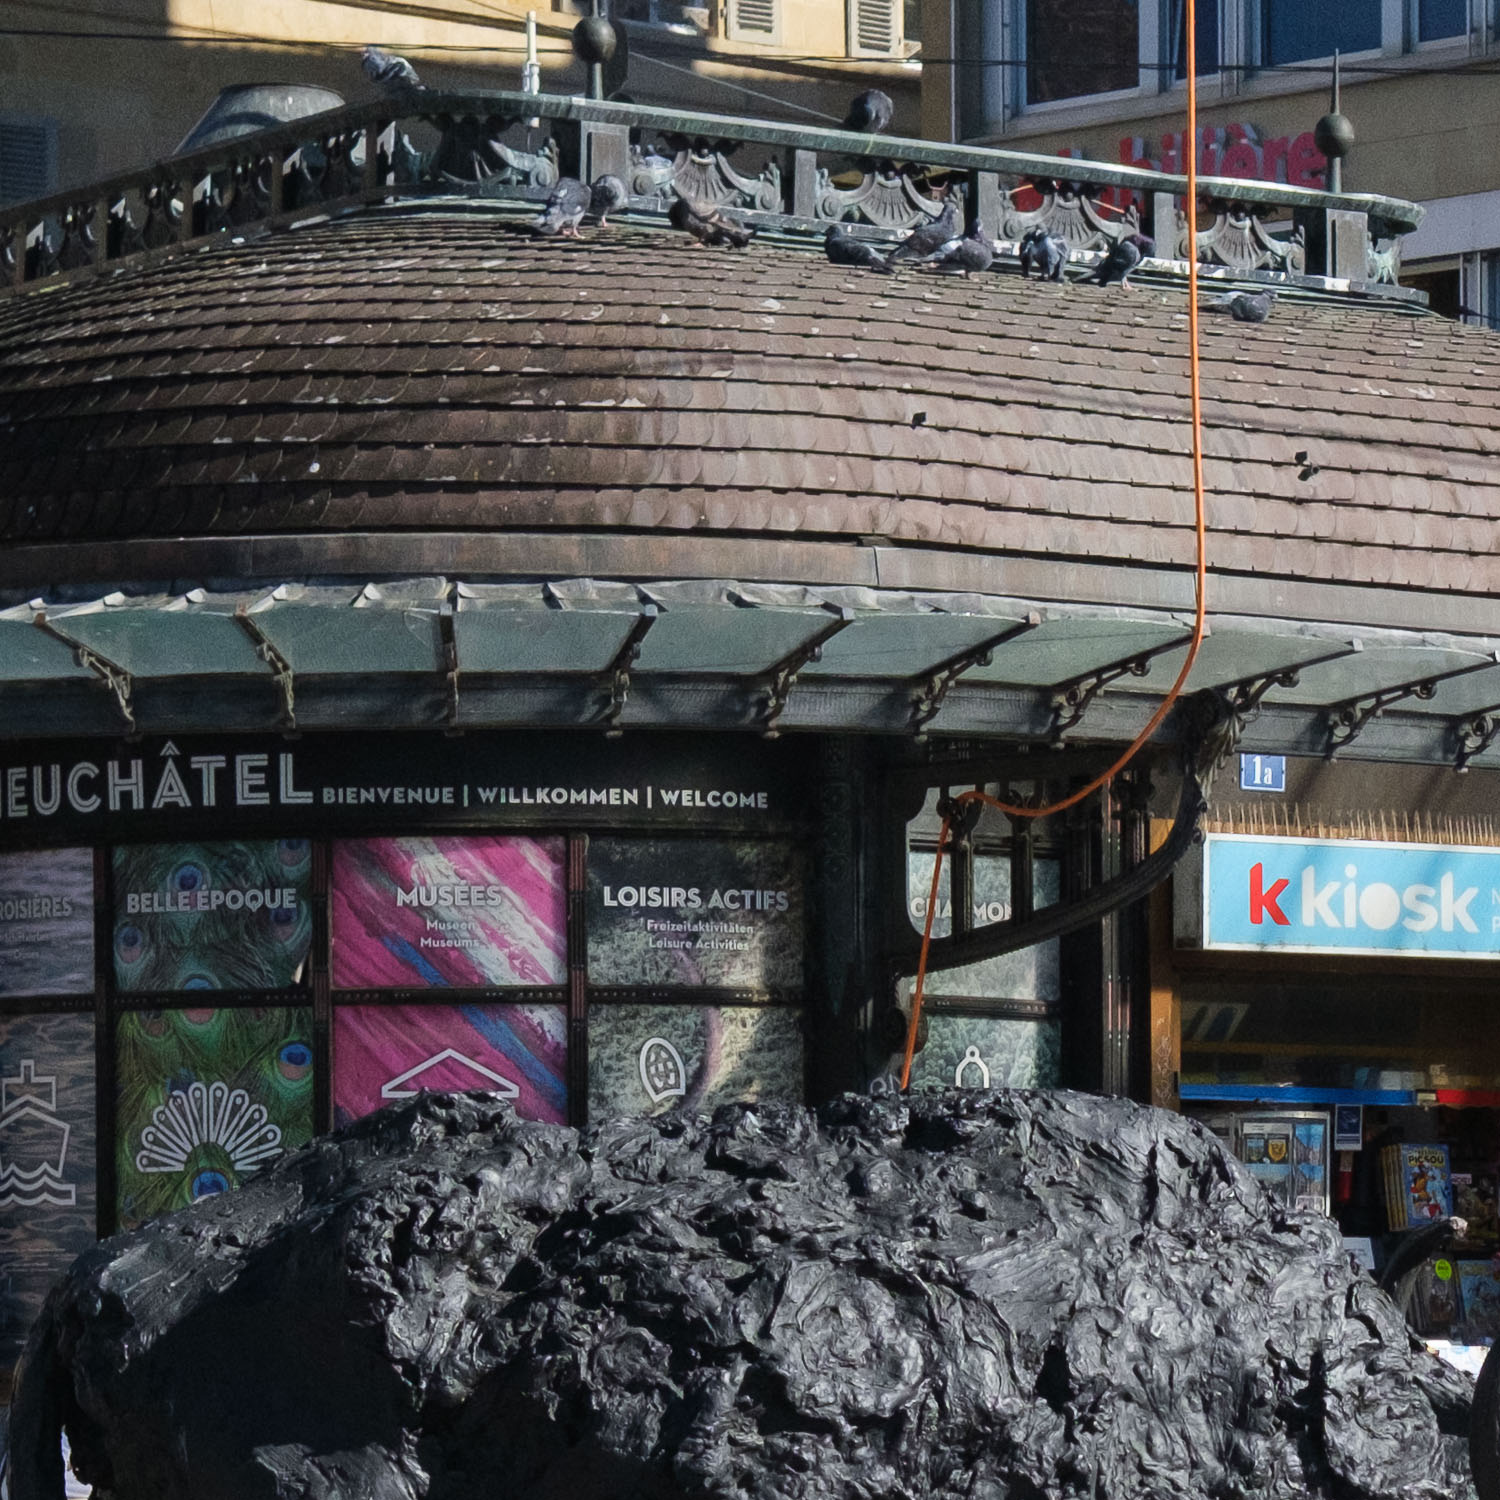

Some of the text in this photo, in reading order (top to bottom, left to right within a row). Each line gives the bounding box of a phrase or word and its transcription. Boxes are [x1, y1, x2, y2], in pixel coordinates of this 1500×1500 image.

[0, 741, 313, 817] EUCHÂTEL
[1253, 755, 1273, 785] 1a
[322, 786, 769, 809] BIENVENUE WILLKOMMEN WELCOME
[126, 884, 298, 914] BELLE ÉPOQUE
[396, 879, 502, 907] MUSÉES
[603, 885, 789, 912] LOISIRS ACTIFS
[1301, 863, 1480, 934] kiosk
[426, 918, 477, 931] Museen
[646, 918, 754, 934] Freizeitaktivitäten
[419, 936, 480, 948] Museums
[649, 937, 751, 951] Leisure Activities
